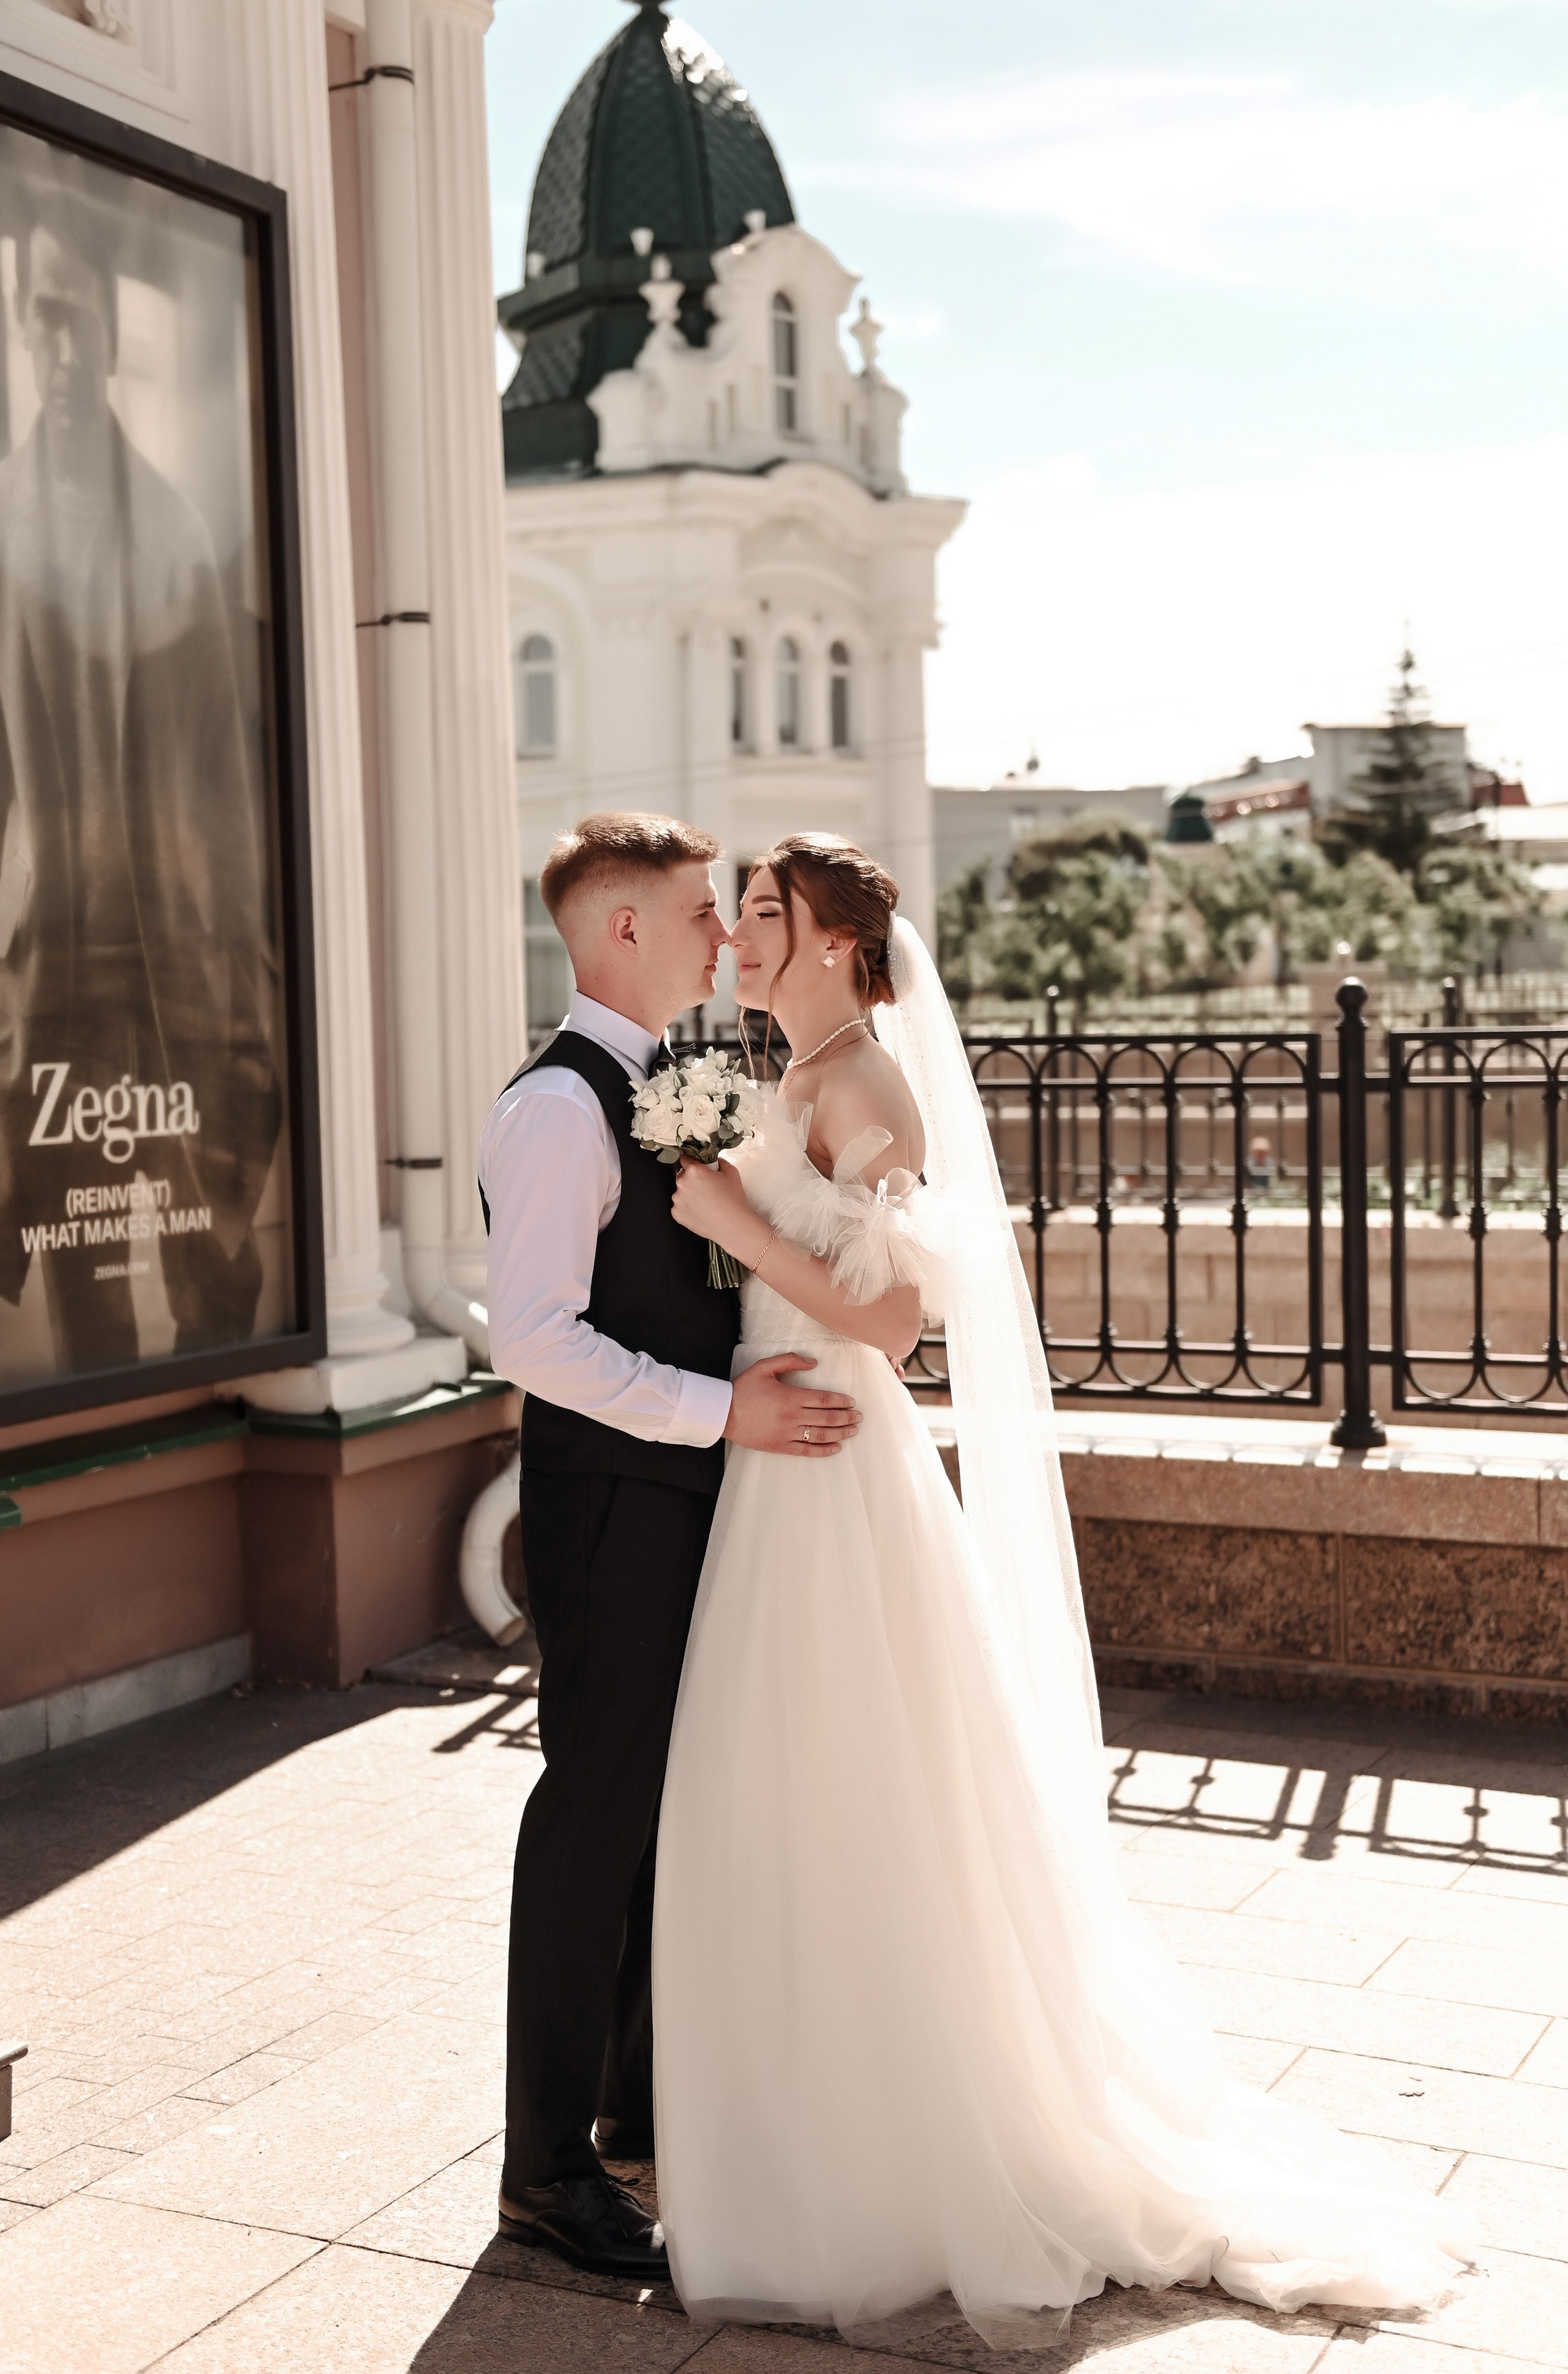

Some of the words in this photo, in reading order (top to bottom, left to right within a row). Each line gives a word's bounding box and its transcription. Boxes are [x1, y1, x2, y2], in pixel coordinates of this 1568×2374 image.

[28, 1063, 200, 1163] Zegna
[66, 1180, 172, 1218] (REINVENT)
[21, 1221, 81, 1253] WHAT
[85, 1214, 151, 1245] MAKES
[154, 1213, 167, 1237] A
[170, 1207, 211, 1234] MAN
